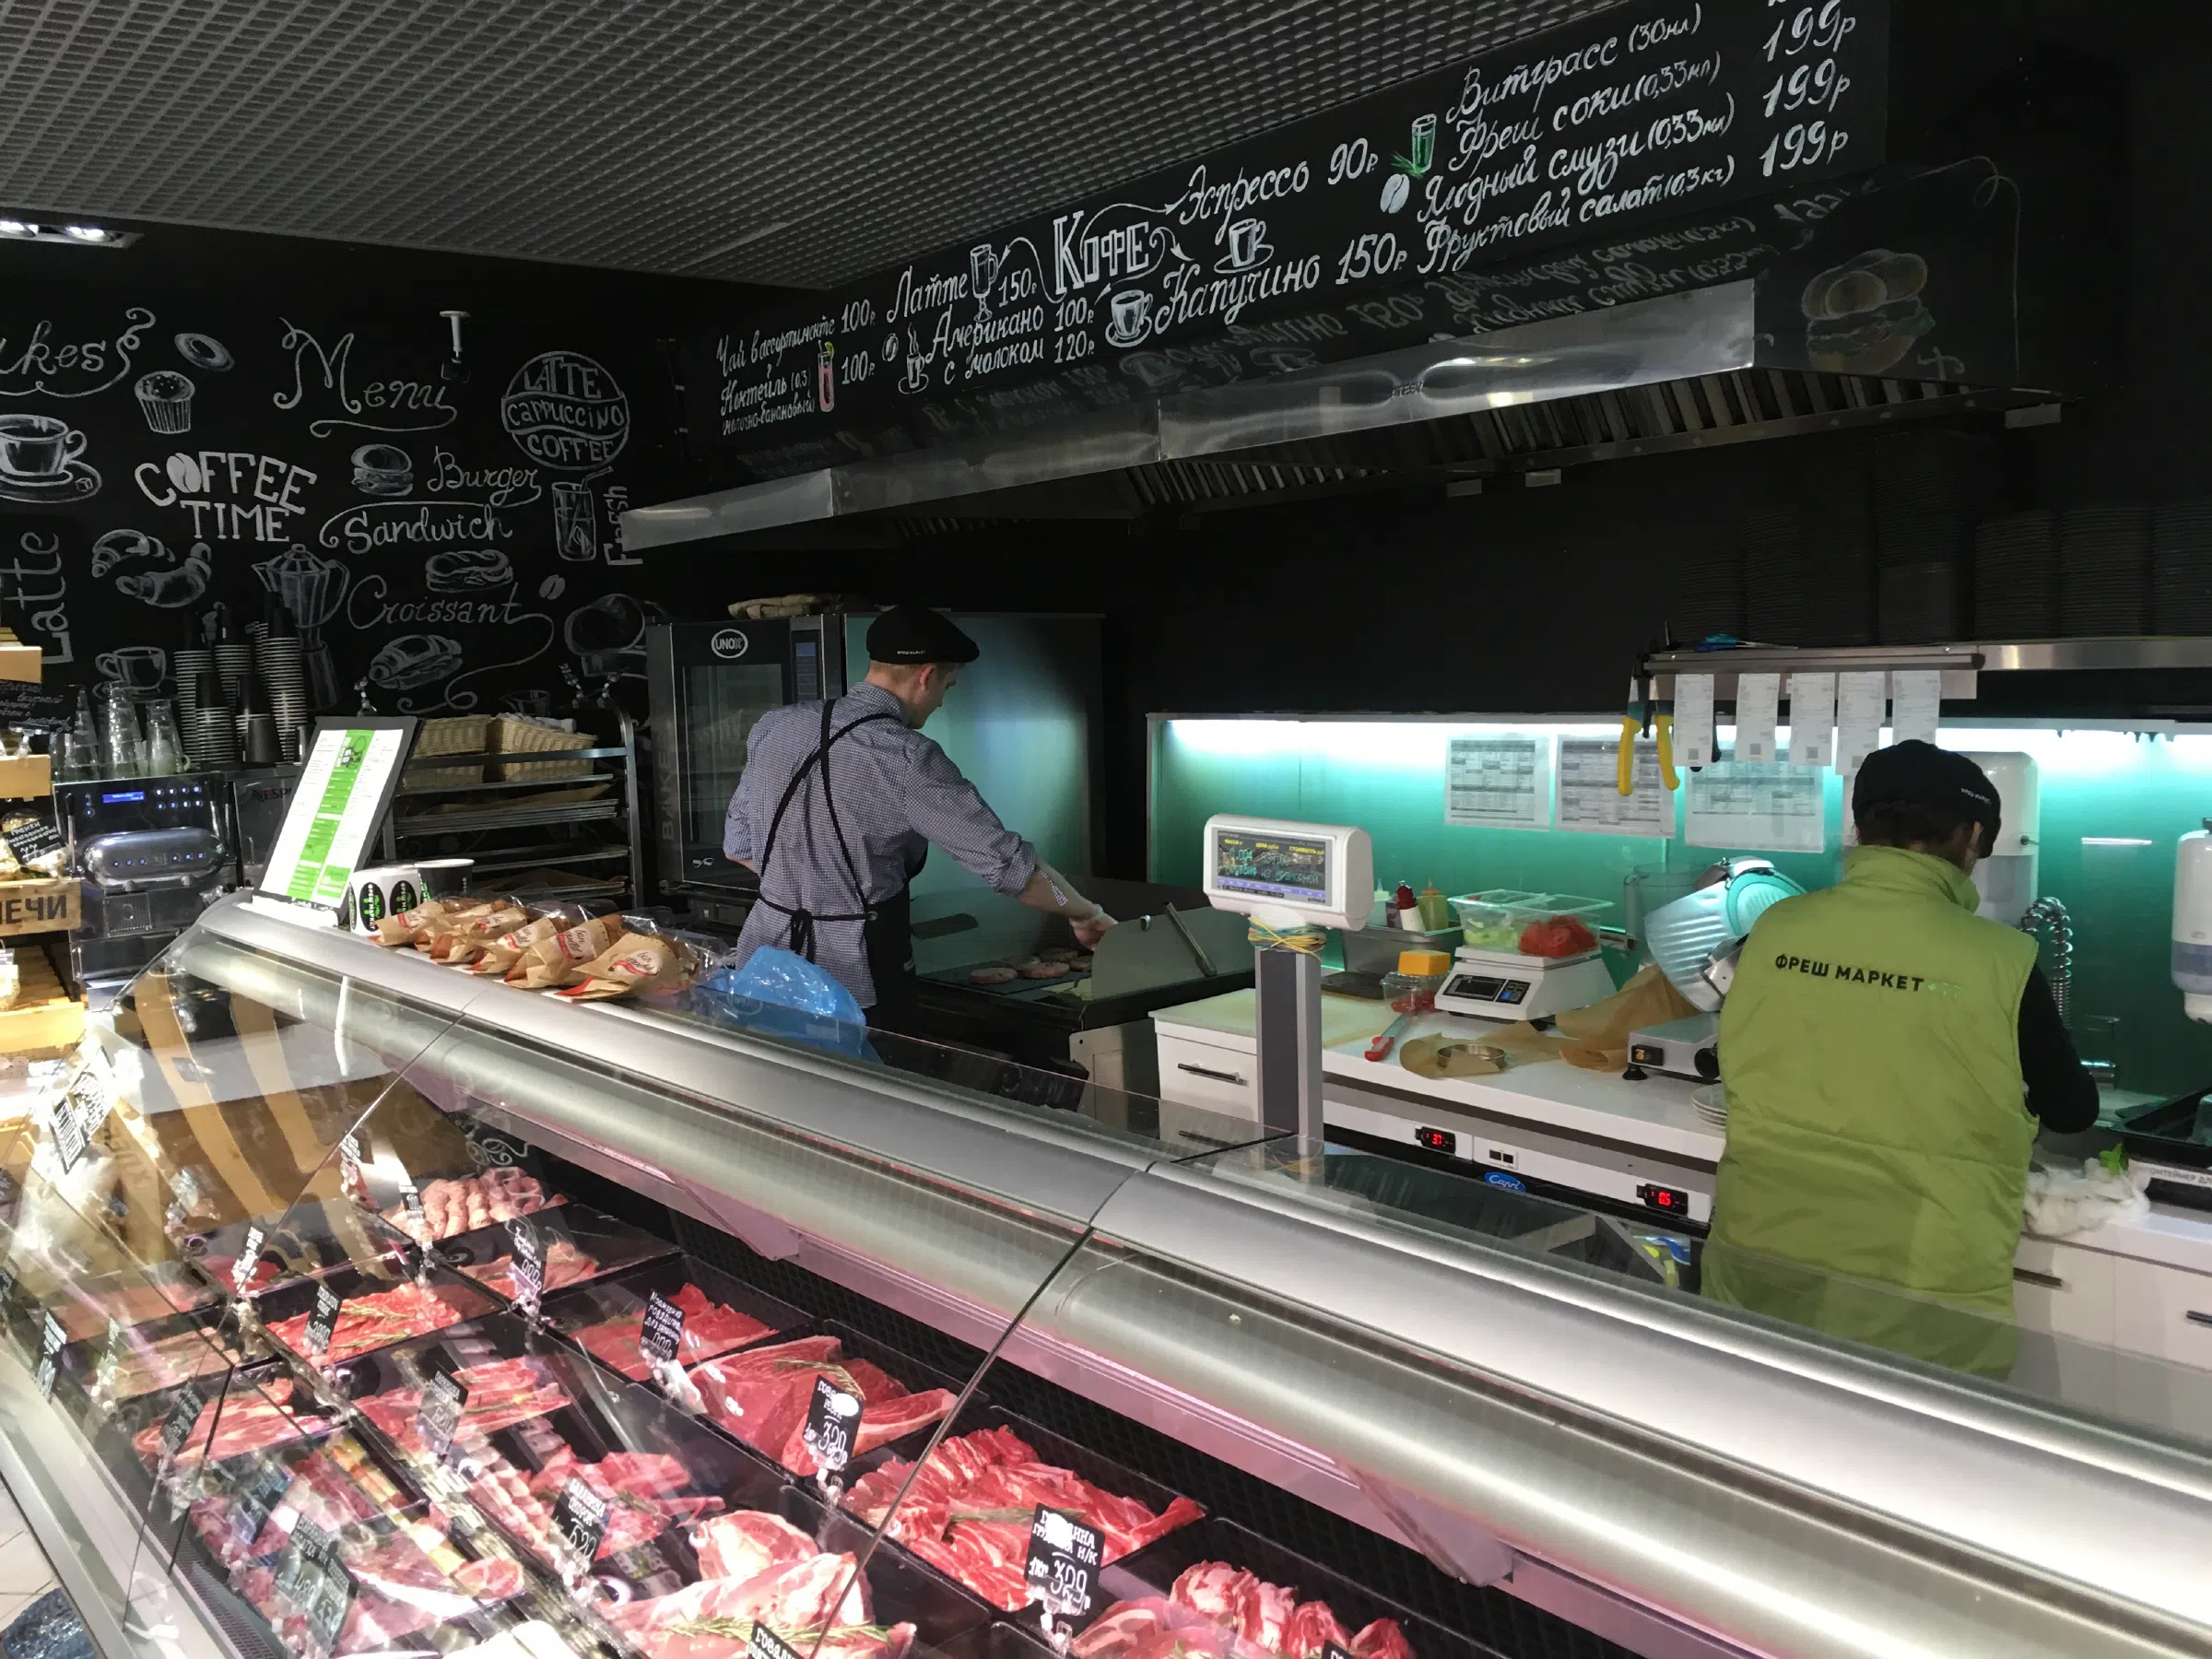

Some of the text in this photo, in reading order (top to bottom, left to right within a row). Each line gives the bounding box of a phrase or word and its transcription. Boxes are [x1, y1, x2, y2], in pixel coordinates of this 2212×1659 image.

[1629, 3, 1701, 53] (30мл)
[1449, 109, 1544, 178] Фреш
[1554, 84, 1633, 131] соки
[1763, 0, 1856, 62] 199р
[1548, 131, 1646, 195] смузи
[1648, 92, 1735, 150] (0,33мл)
[1763, 58, 1851, 118] 199р
[1180, 165, 1309, 245] Эспрессо
[1417, 186, 1571, 274] Фруктовый
[1580, 173, 1664, 222] салат
[1664, 155, 1735, 199] (0,3кг)
[1759, 121, 1849, 177] 199р
[887, 265, 968, 323] Латте
[1154, 255, 1321, 335] Капучино
[0, 320, 106, 375] kes
[716, 335, 747, 377] Чай
[924, 304, 1043, 364] Американо
[965, 338, 1044, 379] молоком
[274, 317, 453, 415] Menu
[524, 357, 601, 398] LATTE
[721, 364, 787, 416] Коктейль
[527, 434, 614, 462] COFFEE
[428, 445, 541, 506] Burger
[181, 500, 291, 542] TIME
[344, 504, 513, 552] Sandwich
[11, 531, 74, 665] Latte
[347, 575, 519, 629] Croissant
[715, 638, 744, 651] UNOX
[1775, 954, 1924, 992] ФРЕШ МАРКЕТ
[1488, 1174, 1520, 1191] Capri
